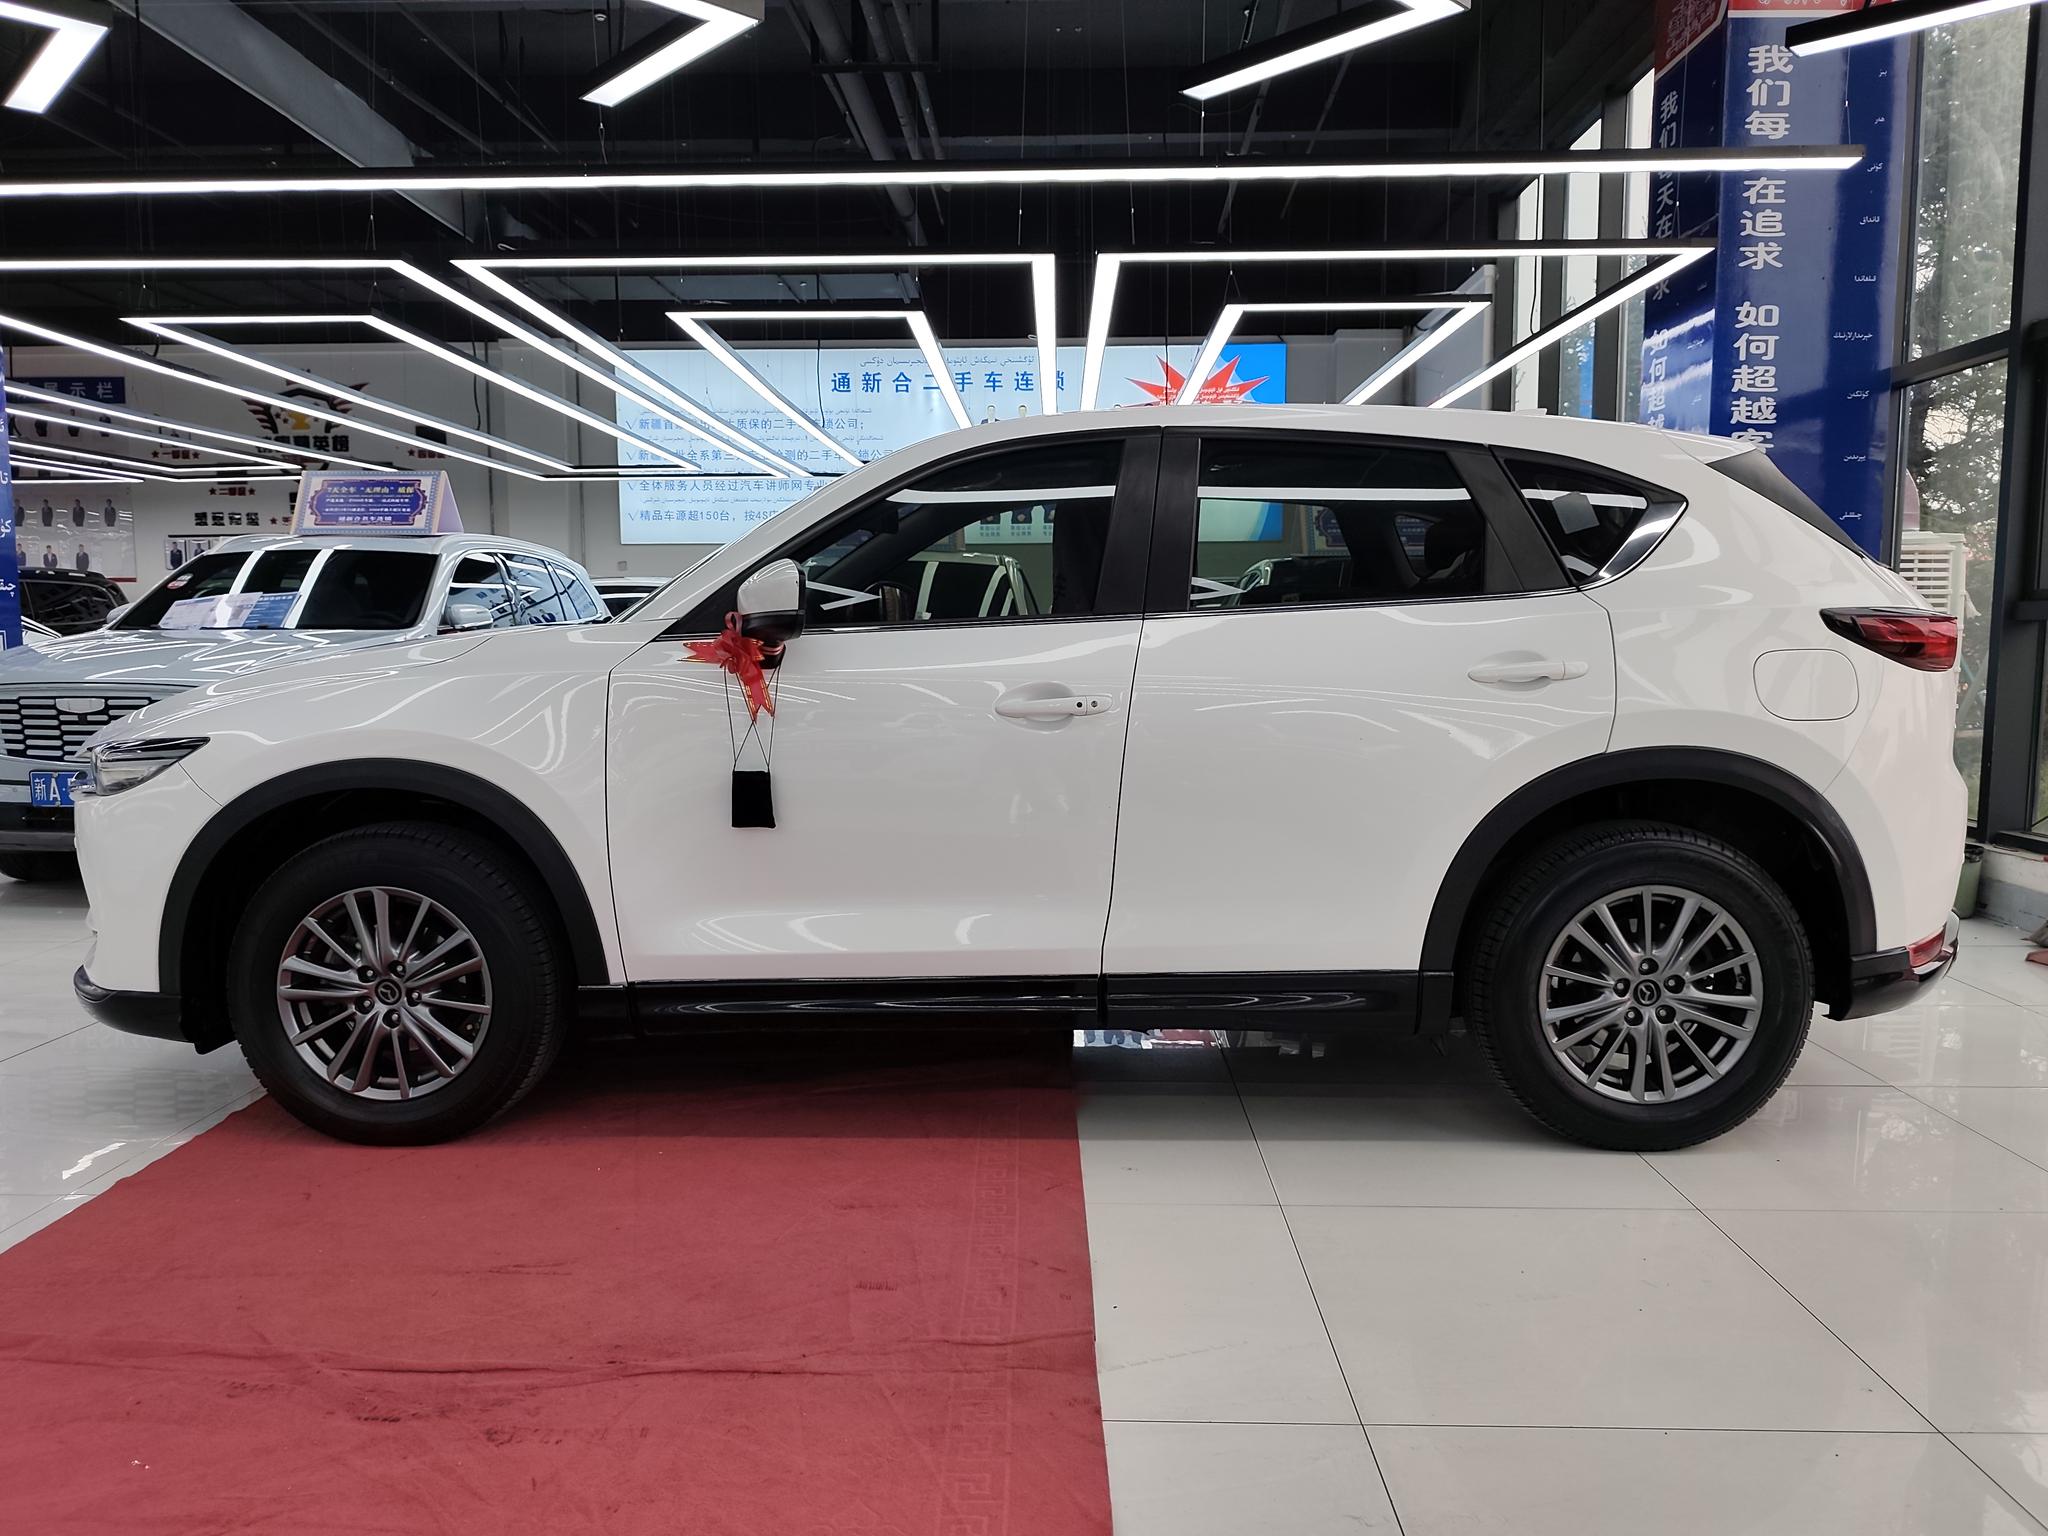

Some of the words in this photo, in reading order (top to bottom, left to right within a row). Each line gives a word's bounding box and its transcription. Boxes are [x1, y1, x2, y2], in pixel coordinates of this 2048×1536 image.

[1652, 90, 1680, 300] 我们天在求
[1738, 44, 1793, 270] 我们每在追求
